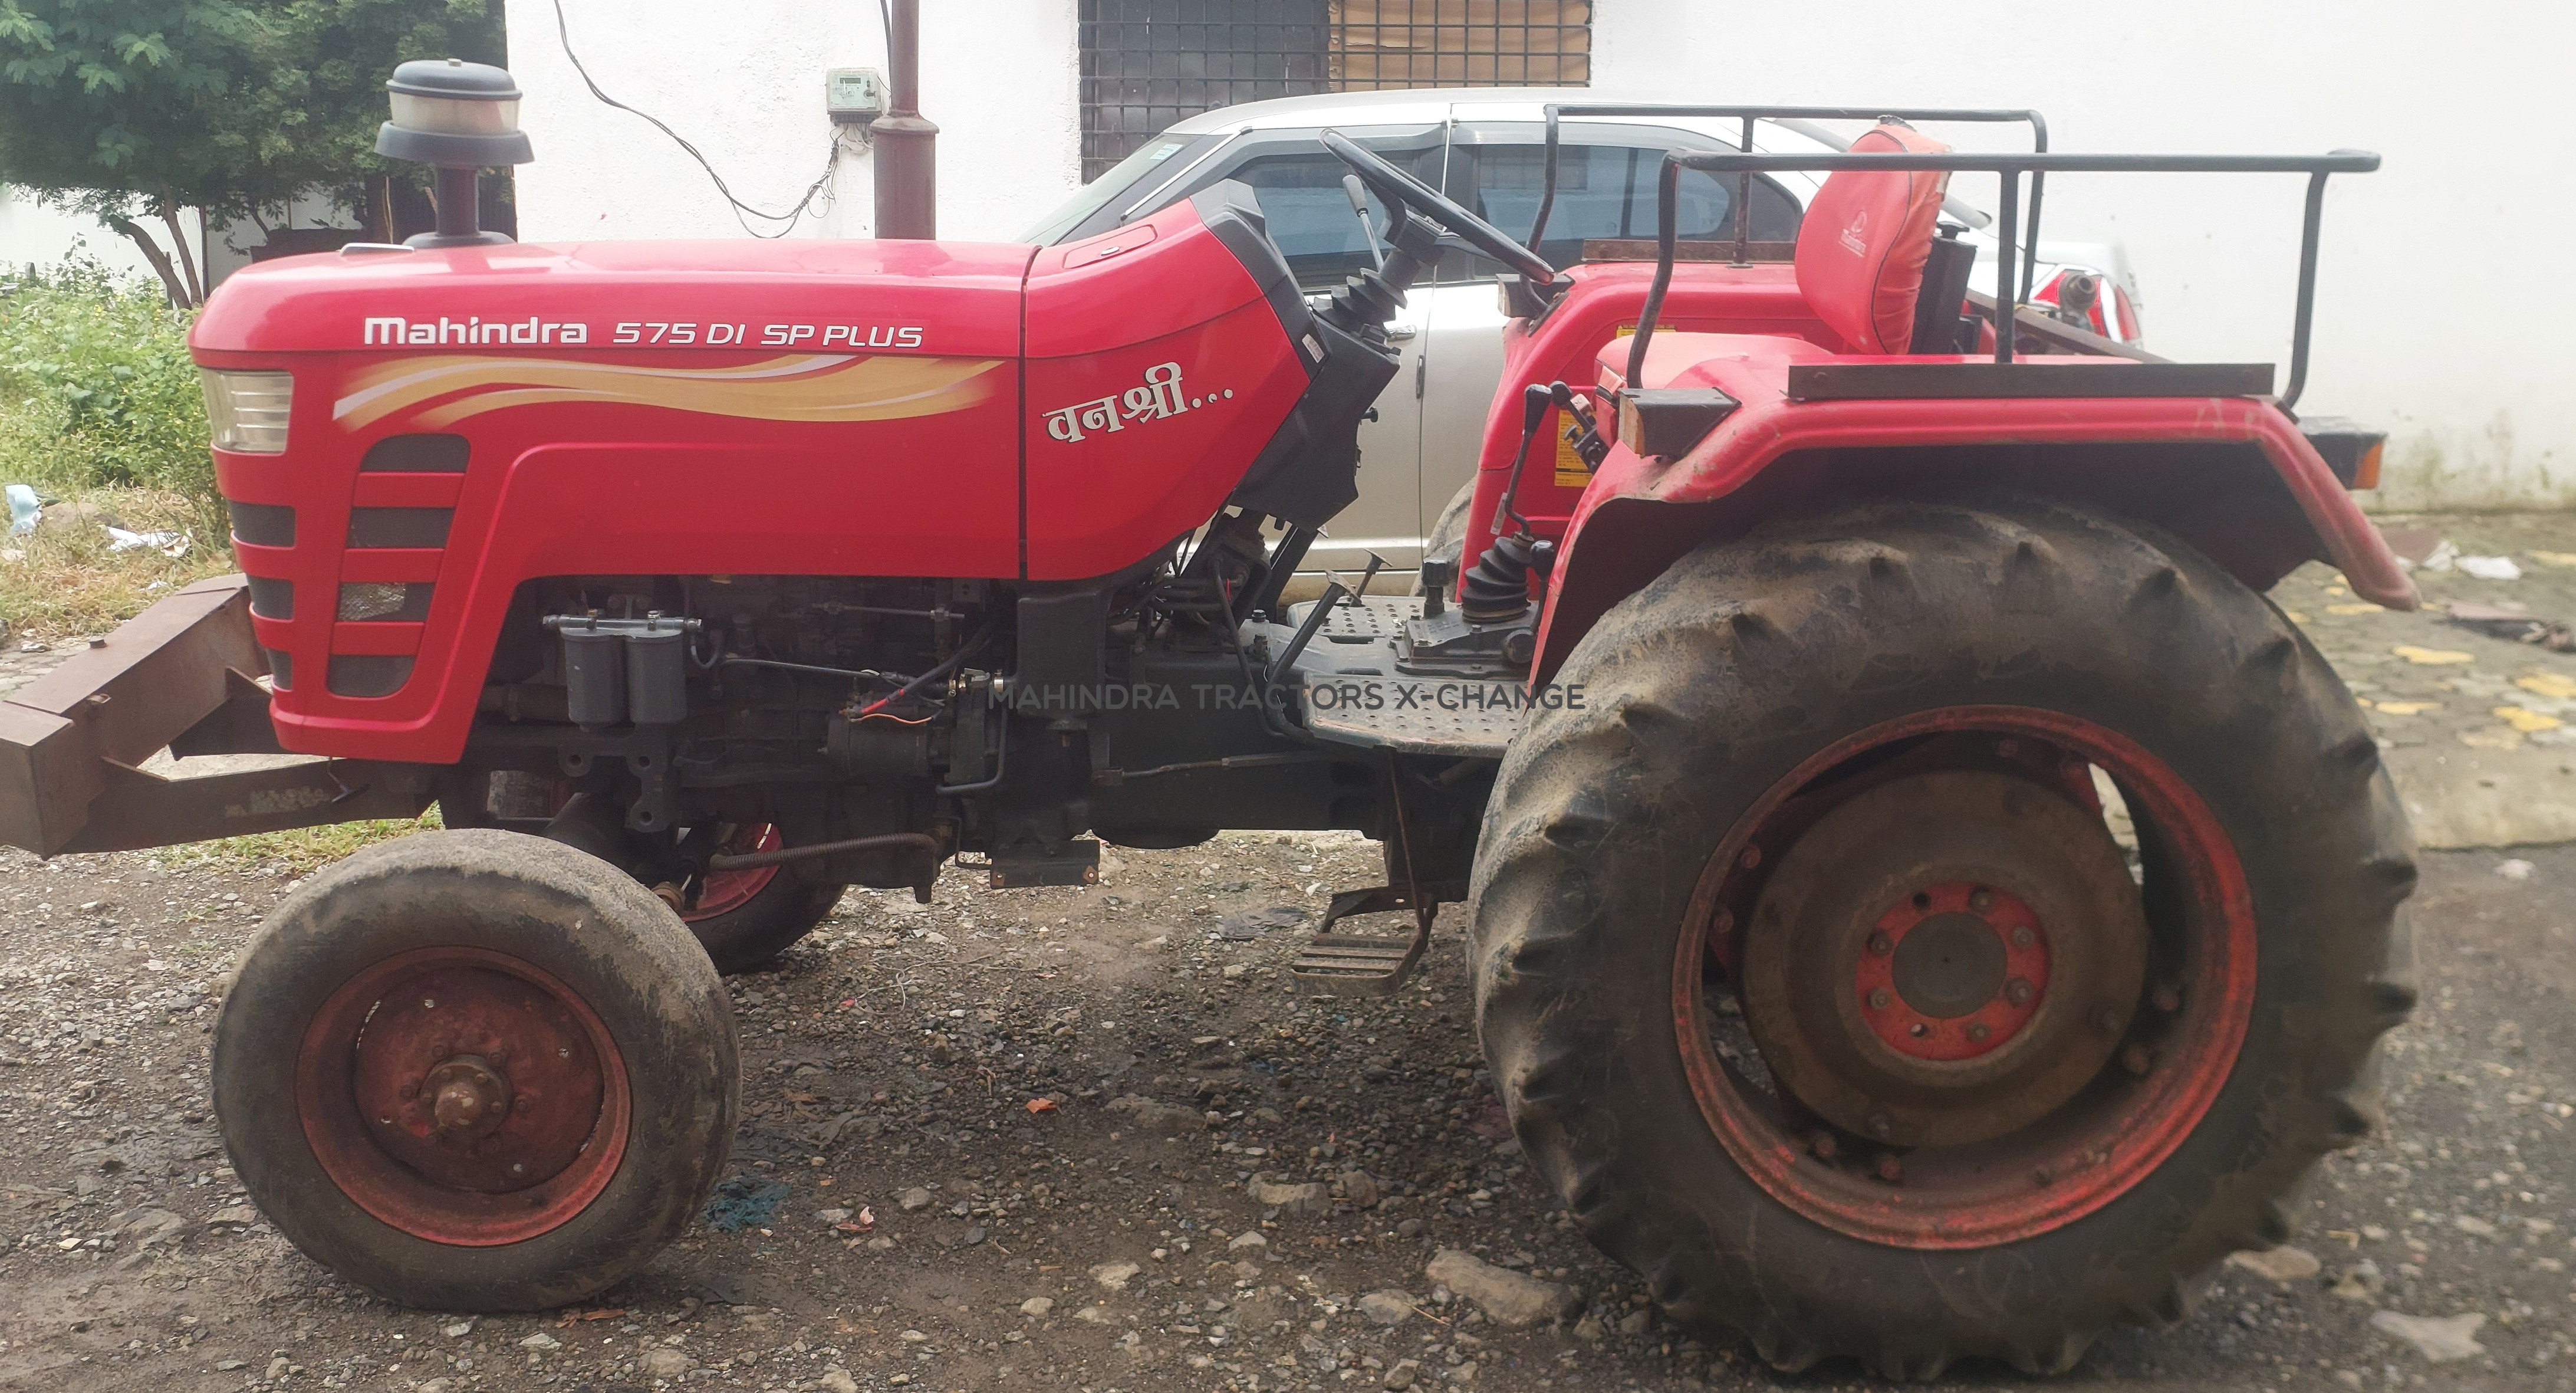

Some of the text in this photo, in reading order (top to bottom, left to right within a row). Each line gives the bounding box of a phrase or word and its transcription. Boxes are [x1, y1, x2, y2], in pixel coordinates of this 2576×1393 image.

[364, 316, 924, 348] Mahindra 575 DI SP PLUS
